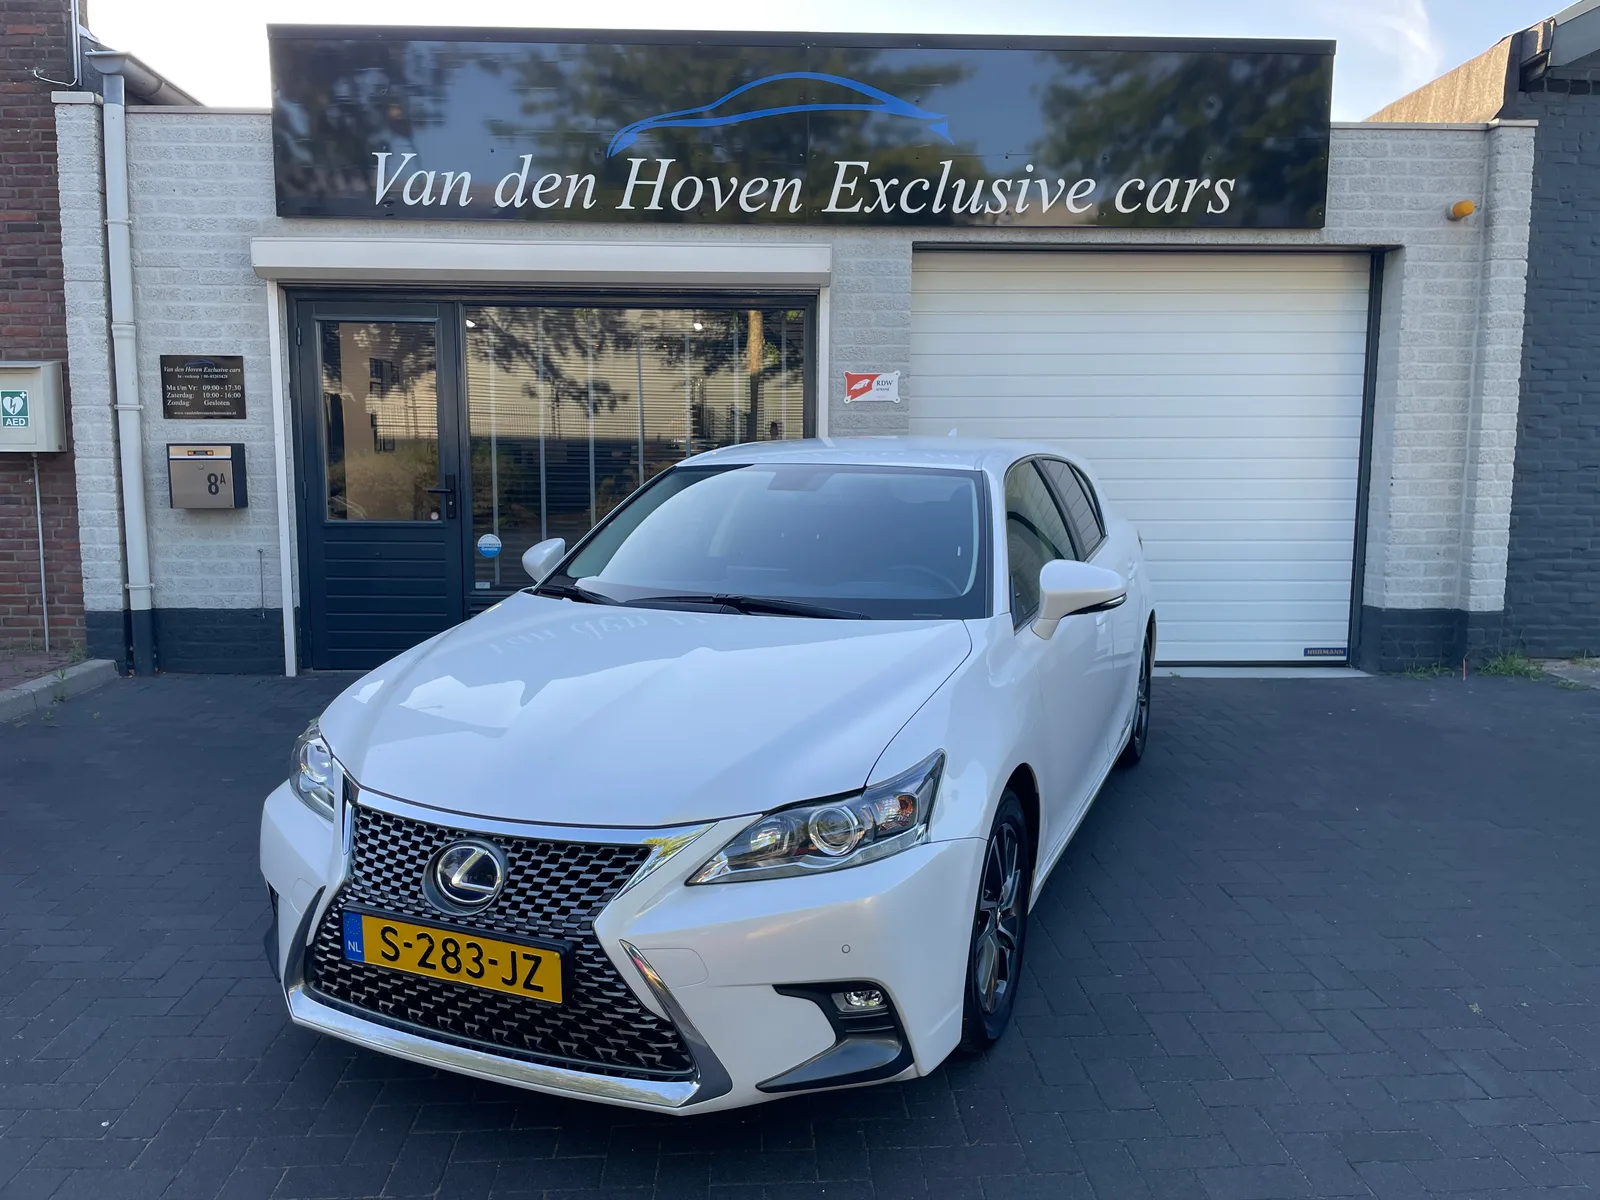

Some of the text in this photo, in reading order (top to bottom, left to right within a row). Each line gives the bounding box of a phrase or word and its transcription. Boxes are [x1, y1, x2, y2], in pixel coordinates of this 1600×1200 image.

[371, 152, 1236, 214] Van den Hoven Exclusive cars
[166, 392, 195, 400] Zaterdag:
[5, 418, 26, 426] AED
[347, 926, 544, 993] NL S-283-JZ
